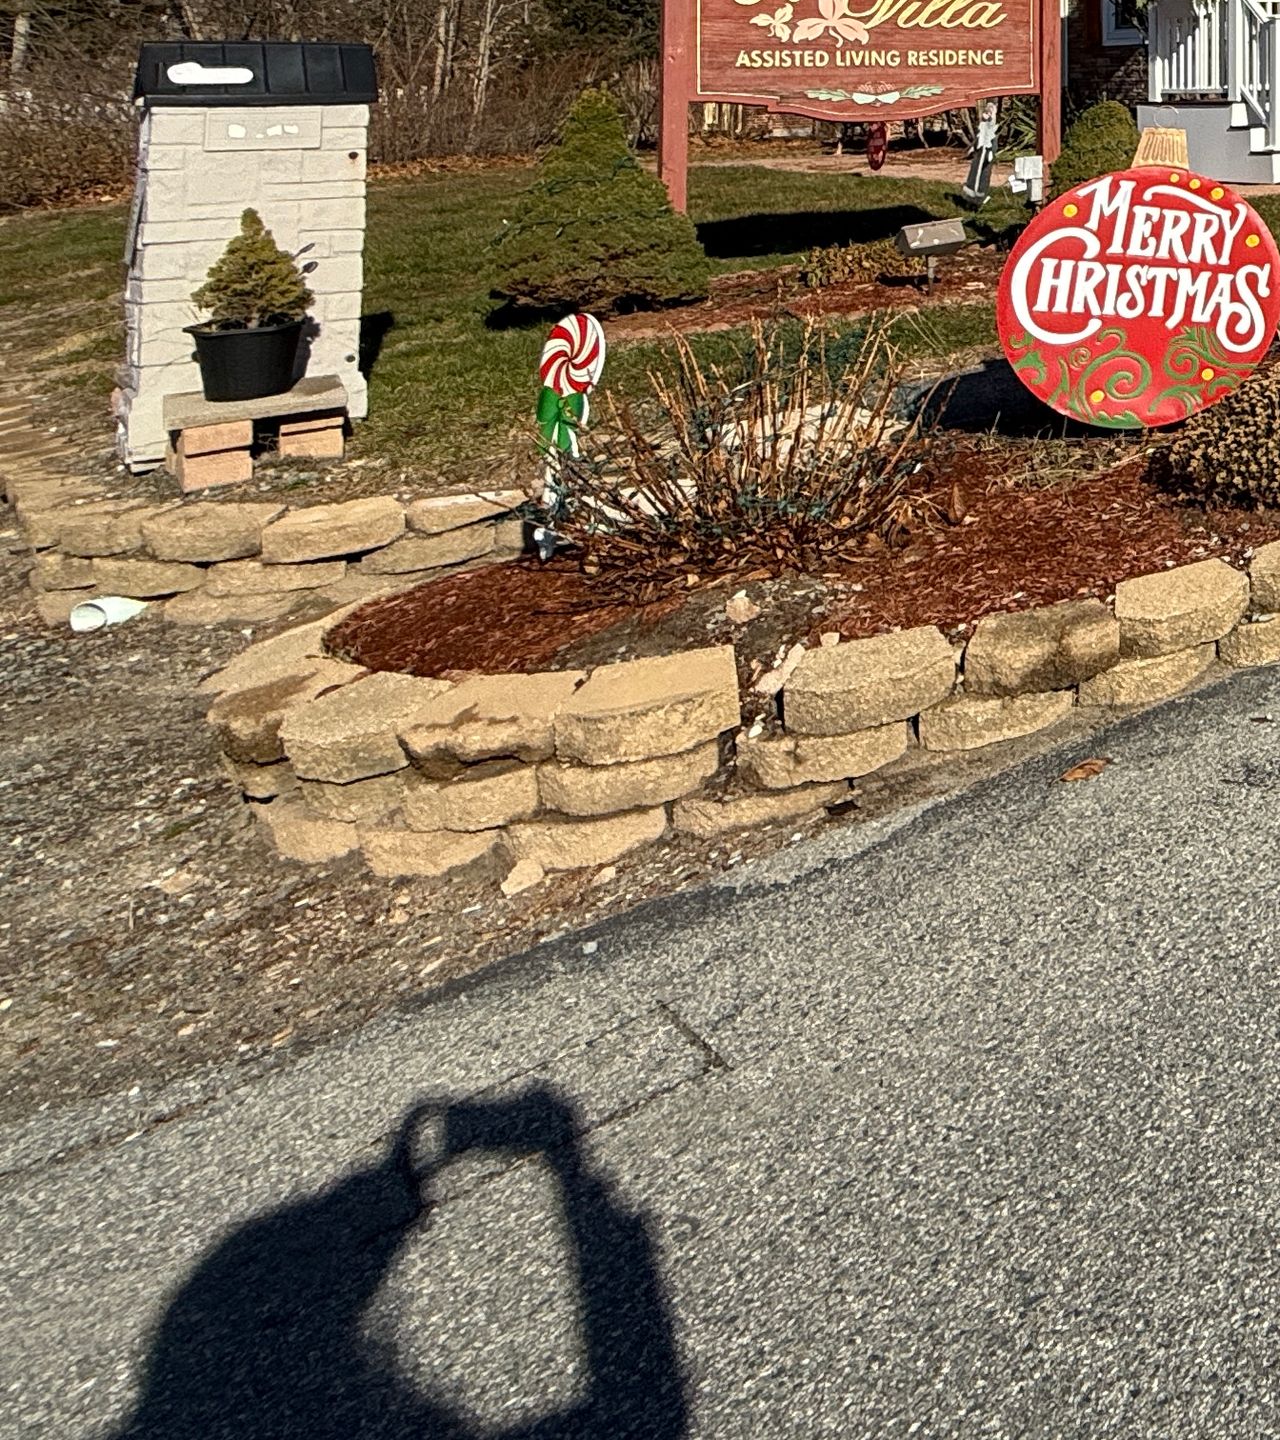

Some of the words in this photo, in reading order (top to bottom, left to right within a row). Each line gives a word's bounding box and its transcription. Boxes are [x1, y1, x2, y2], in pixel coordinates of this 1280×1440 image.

[735, 50, 829, 68] ASSISTED
[836, 50, 901, 67] LIVING
[908, 50, 1004, 66] RESIDENCE
[1076, 176, 1247, 265] MERRY
[1010, 227, 1270, 353] CHRISTMAS
